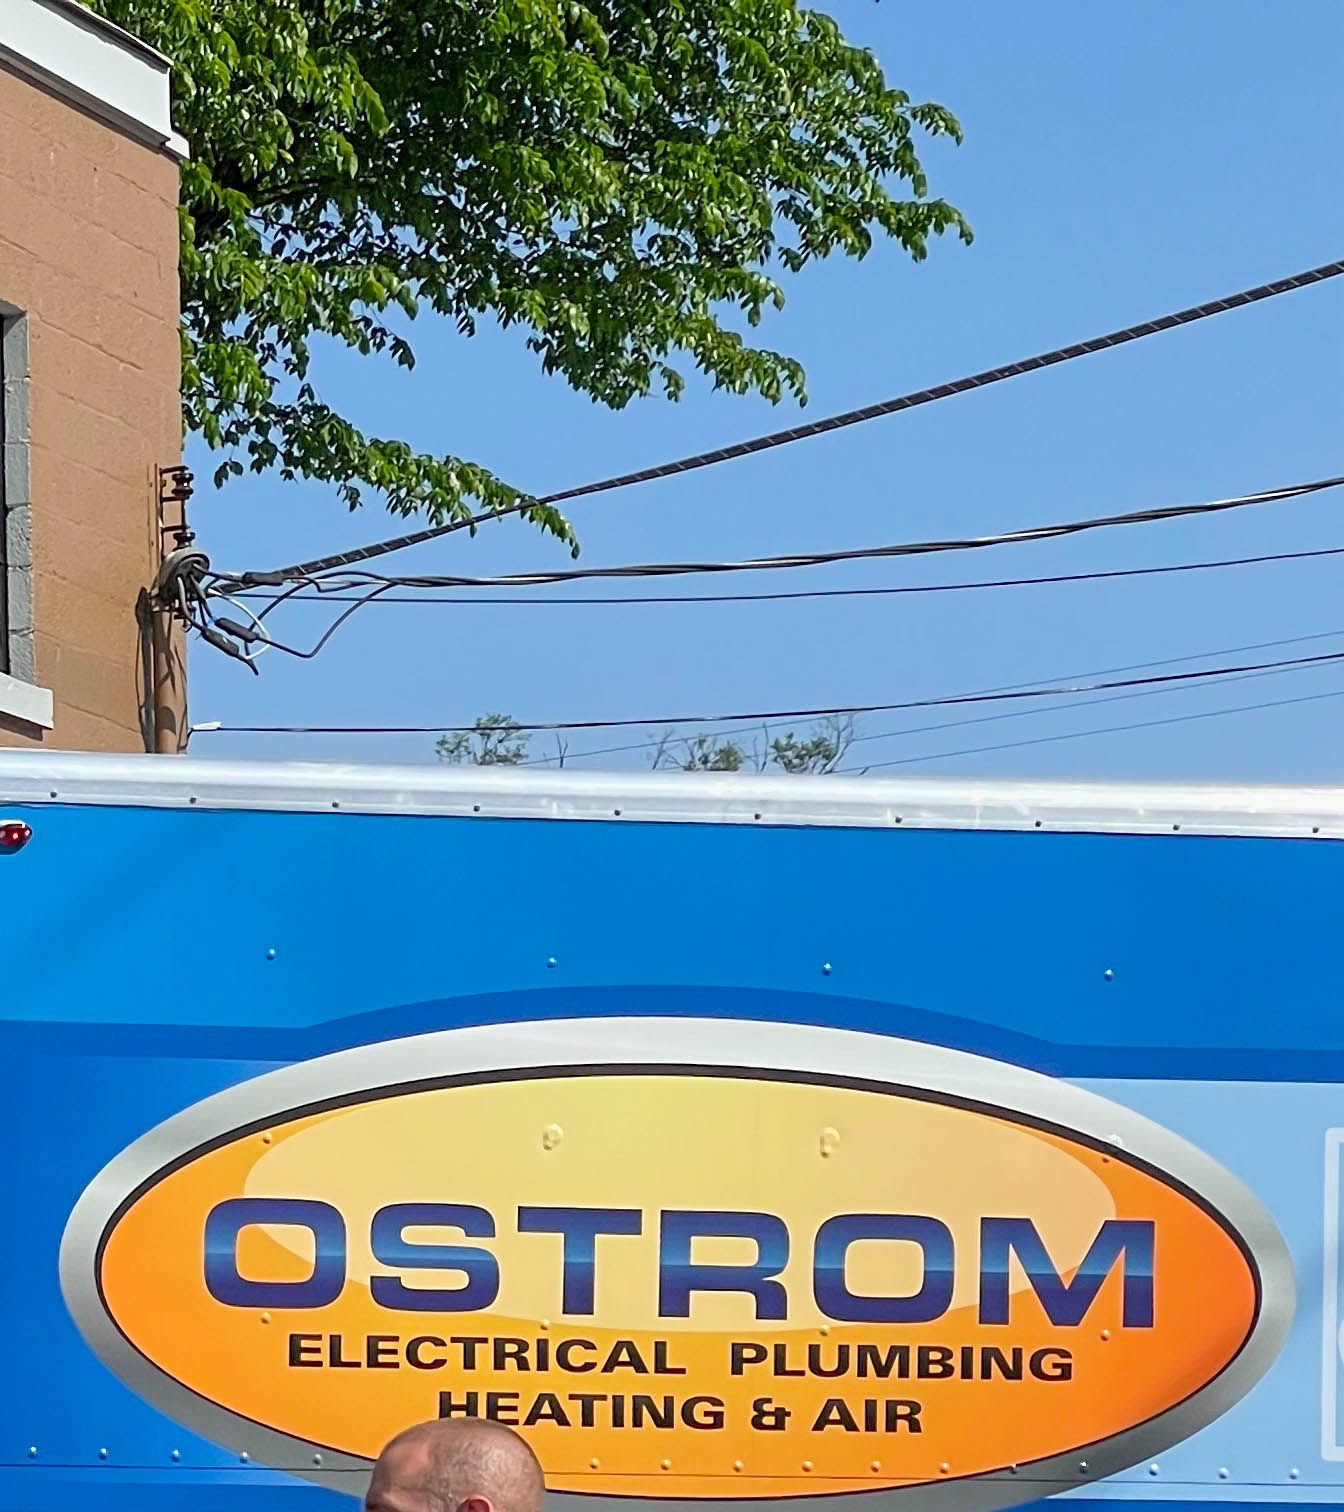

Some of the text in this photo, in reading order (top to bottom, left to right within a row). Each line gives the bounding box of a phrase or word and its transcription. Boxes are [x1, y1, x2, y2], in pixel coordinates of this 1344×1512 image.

[204, 1197, 1156, 1329] OSTROM
[288, 1332, 1074, 1382] ELECTRICAL PLUMBING
[438, 1390, 924, 1434] HEATING & AIR
